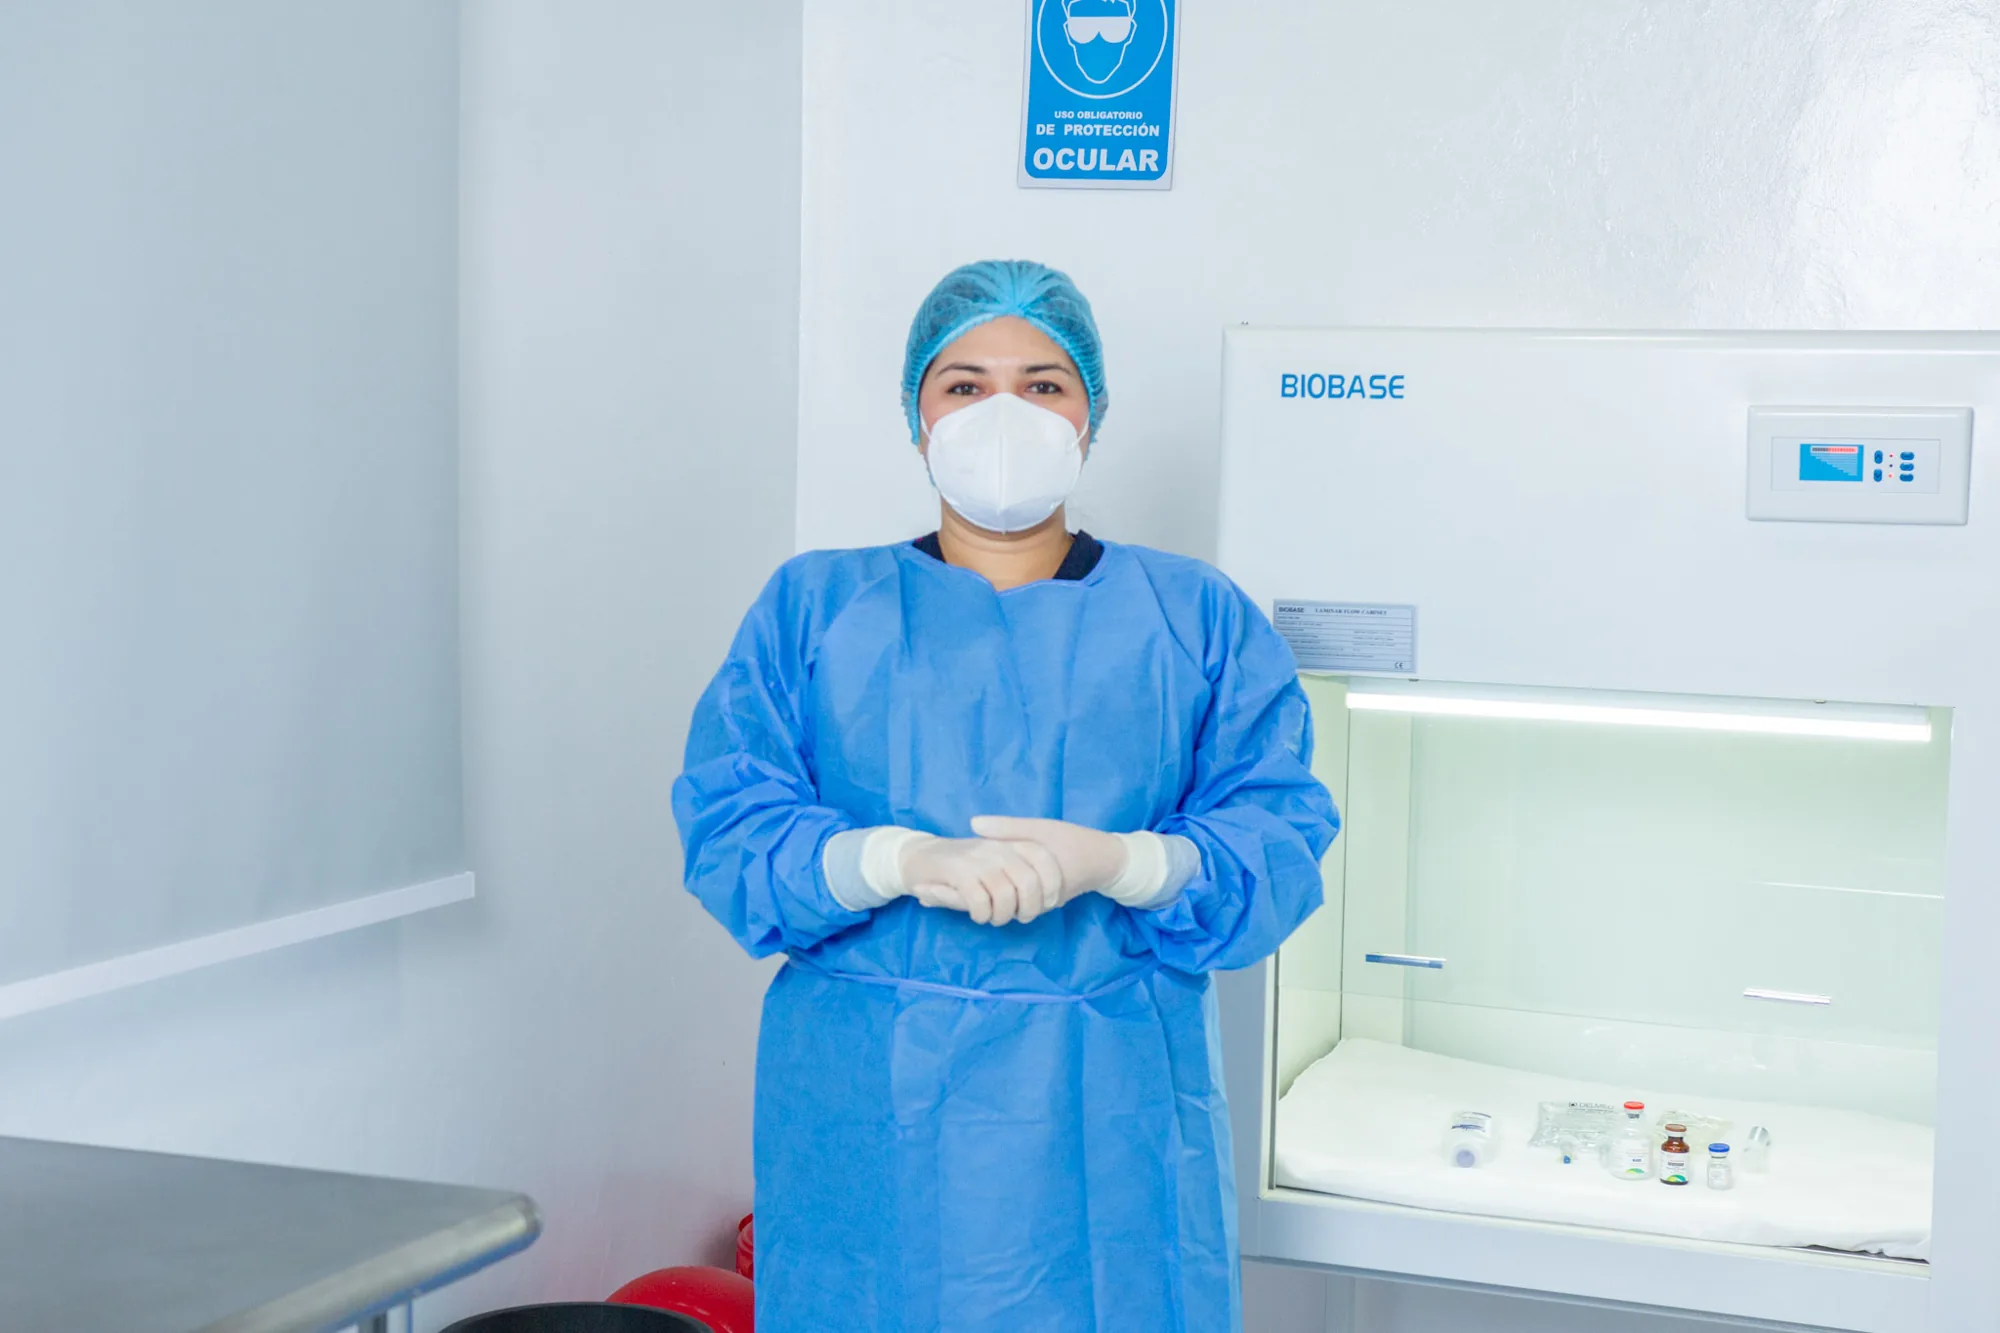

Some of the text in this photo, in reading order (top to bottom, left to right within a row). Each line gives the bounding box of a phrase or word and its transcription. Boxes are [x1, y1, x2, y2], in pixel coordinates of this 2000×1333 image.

[1054, 111, 1143, 120] USO OBLIGATORIO
[1036, 122, 1160, 137] DE PROTECCIÓN
[1033, 147, 1159, 172] OCULAR
[1281, 373, 1405, 399] BIOBASE
